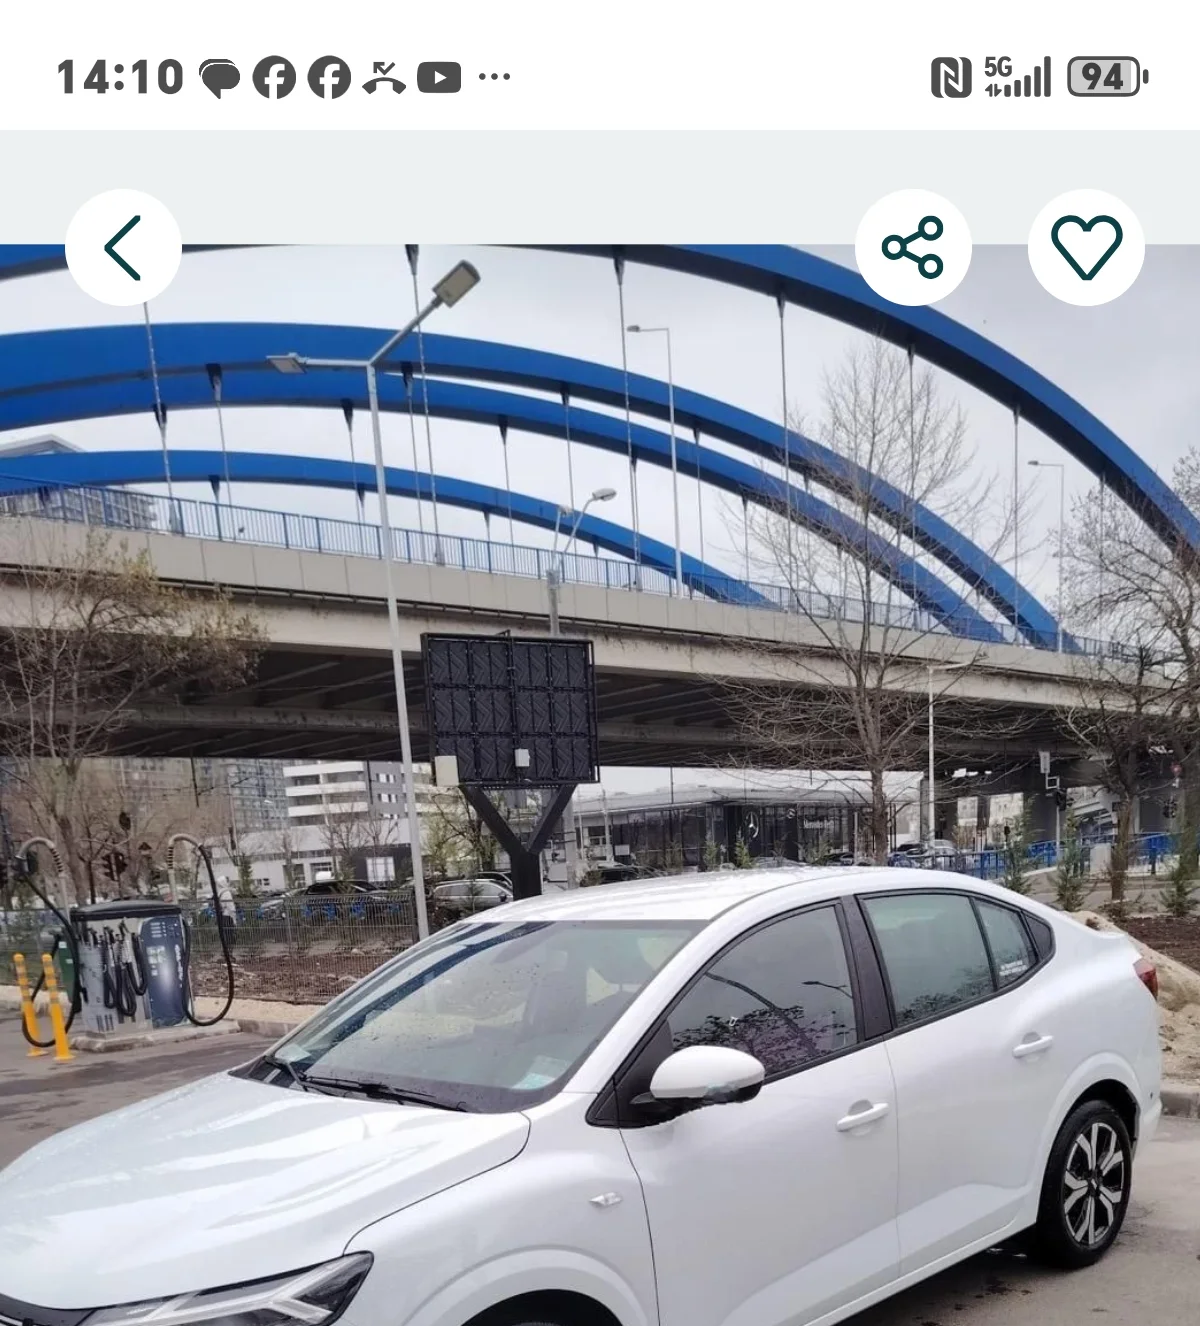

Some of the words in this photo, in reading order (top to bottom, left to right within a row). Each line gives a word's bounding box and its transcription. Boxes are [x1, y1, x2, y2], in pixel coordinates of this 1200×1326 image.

[58, 59, 183, 95] 14:10
[984, 55, 1013, 78] 5G
[1081, 62, 1124, 90] 94
